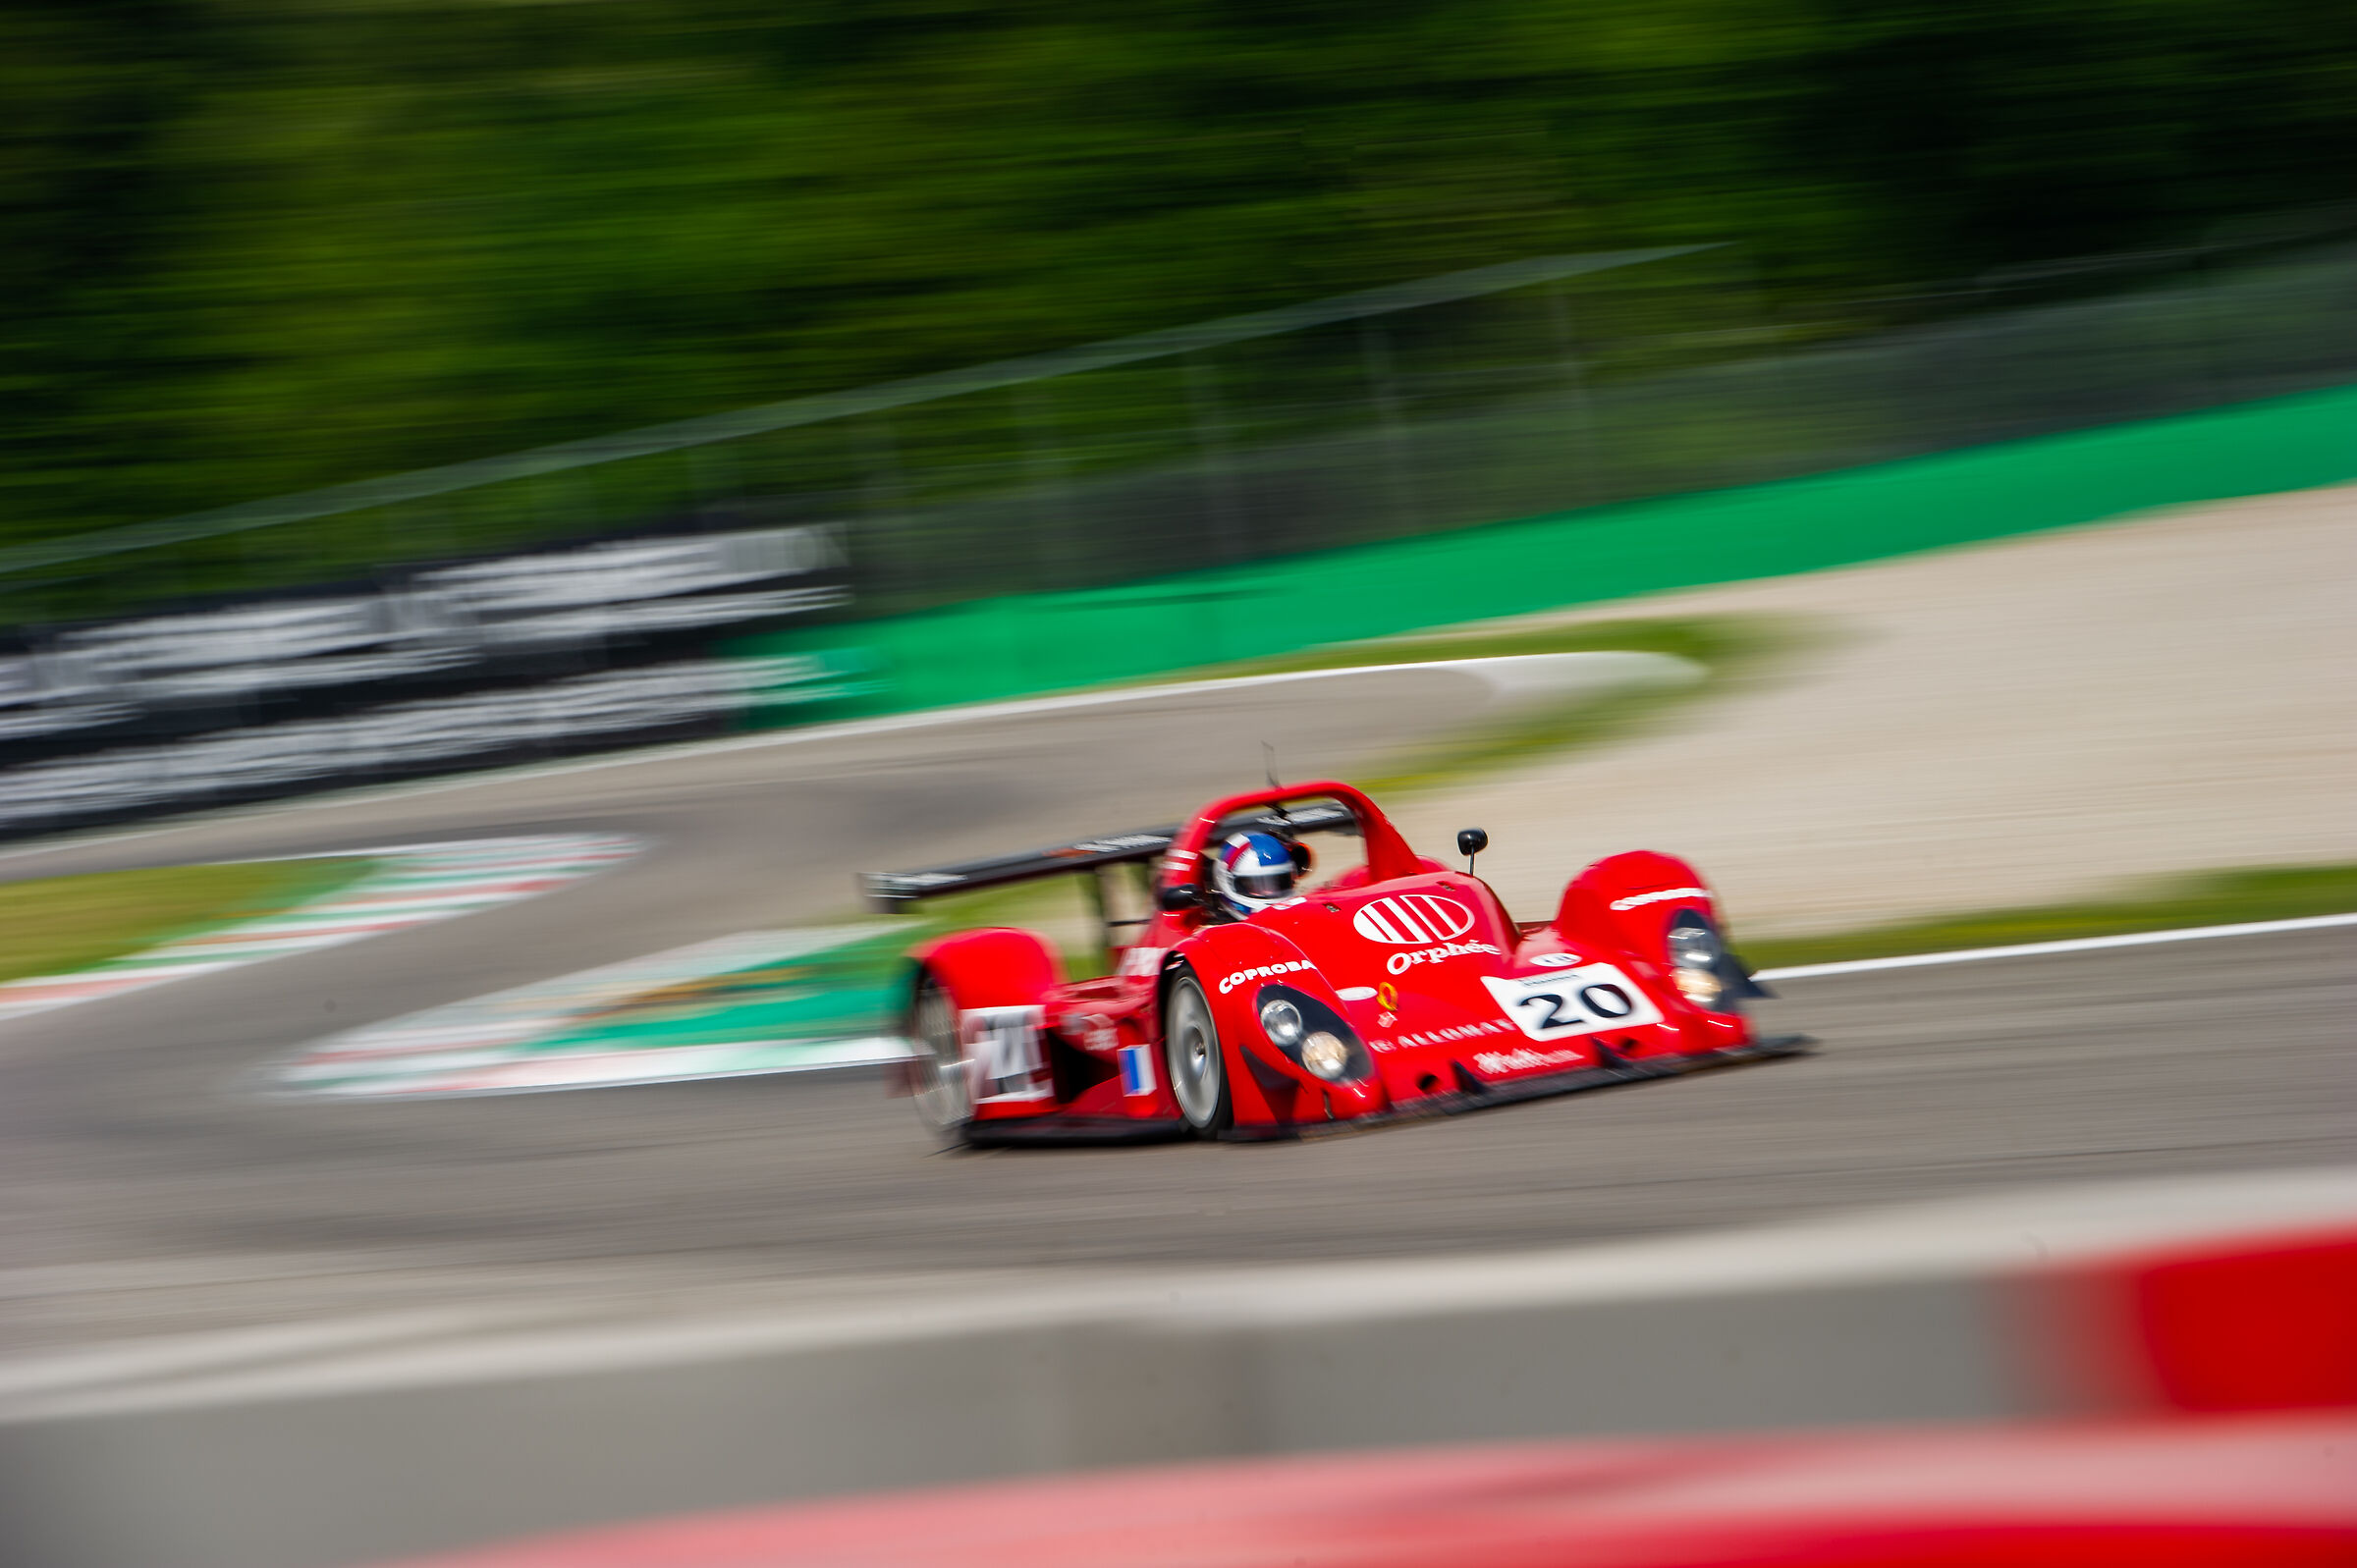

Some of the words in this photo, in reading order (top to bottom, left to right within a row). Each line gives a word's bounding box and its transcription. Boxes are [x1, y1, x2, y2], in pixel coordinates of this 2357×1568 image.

[1387, 940, 1502, 975] Orphée
[1219, 959, 1317, 994] COPROBA
[1518, 983, 1632, 1030] 20
